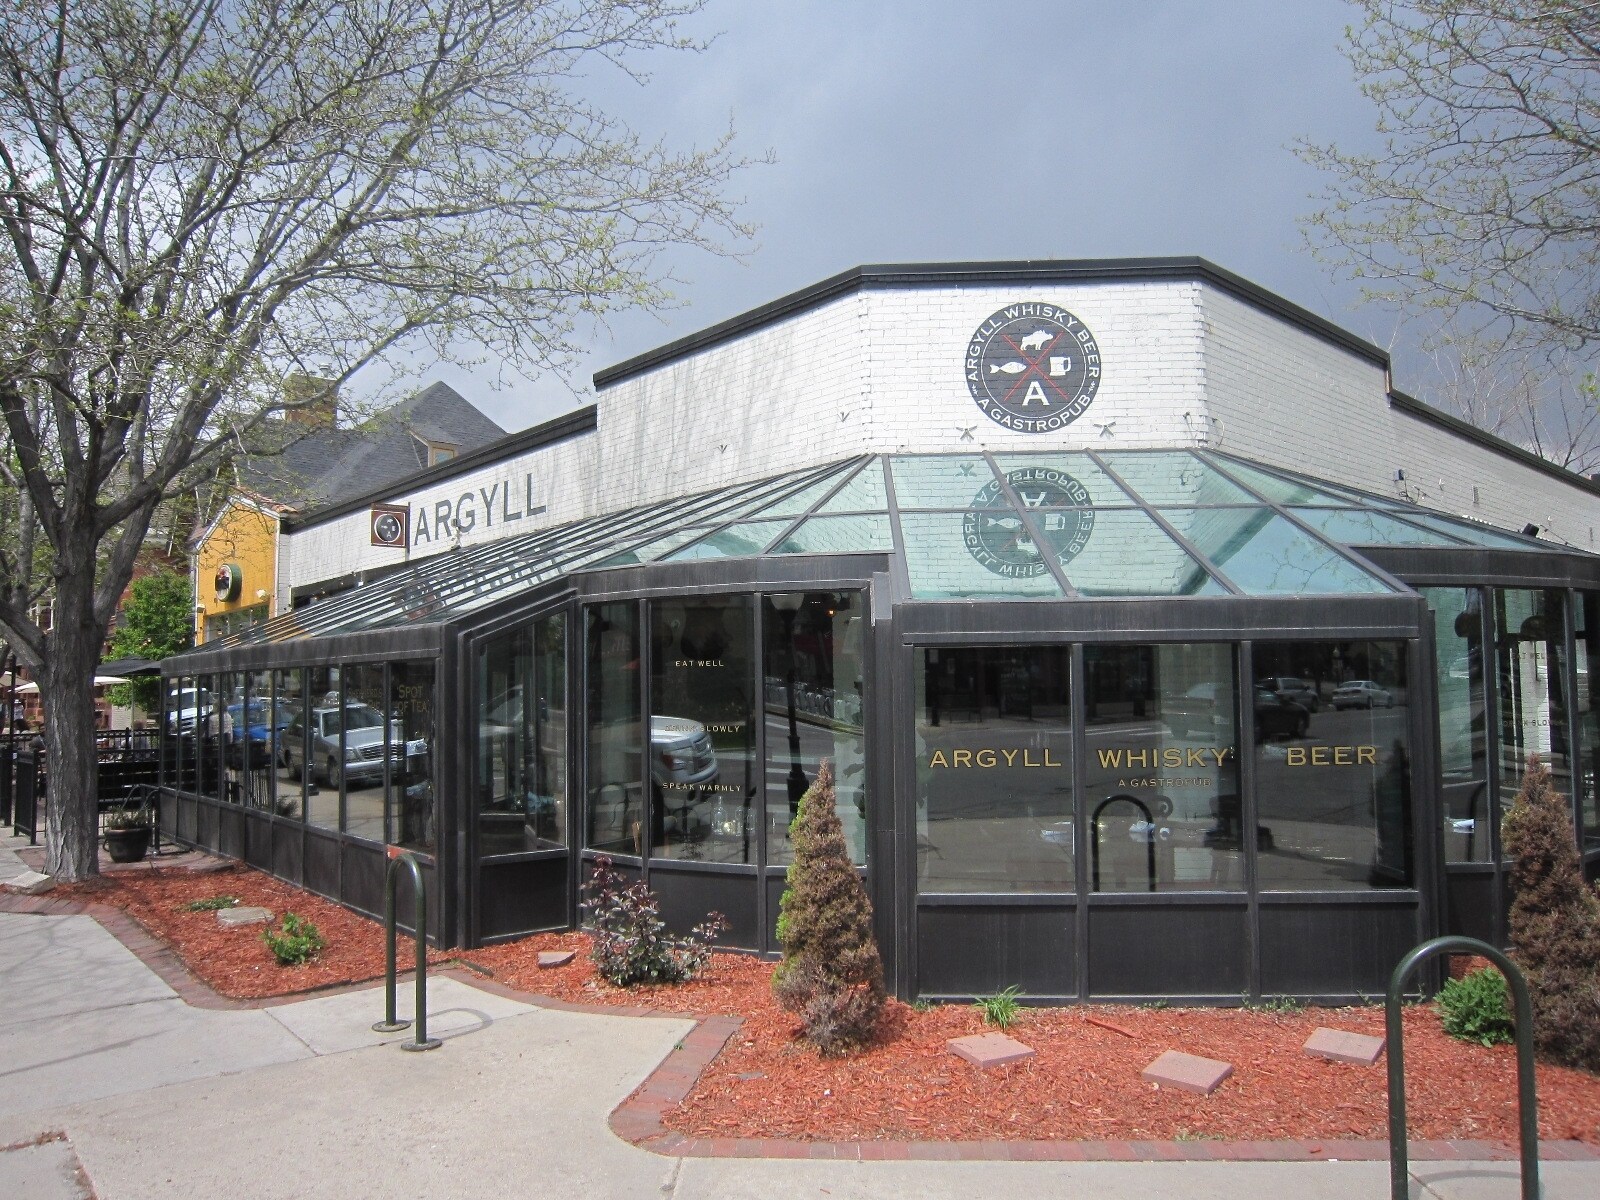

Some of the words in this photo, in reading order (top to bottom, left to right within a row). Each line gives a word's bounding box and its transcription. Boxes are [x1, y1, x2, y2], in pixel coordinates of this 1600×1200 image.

[968, 319, 1002, 382] ARGYLL
[1004, 304, 1078, 328] WHISKY
[1077, 329, 1100, 379] BEER
[1022, 381, 1050, 406] A
[978, 398, 990, 410] A
[990, 394, 1091, 431] GASTROPUB
[414, 473, 547, 546] ARGYLL
[700, 725, 740, 733] SLOWLY
[930, 748, 1062, 768] ARGYLL
[1098, 748, 1228, 768] WHISKY
[1287, 746, 1377, 766] BEER
[662, 782, 695, 790] SPEAK
[699, 784, 741, 792] WARMLY
[1118, 778, 1126, 787] A
[1130, 777, 1212, 788] GASTROPUB
